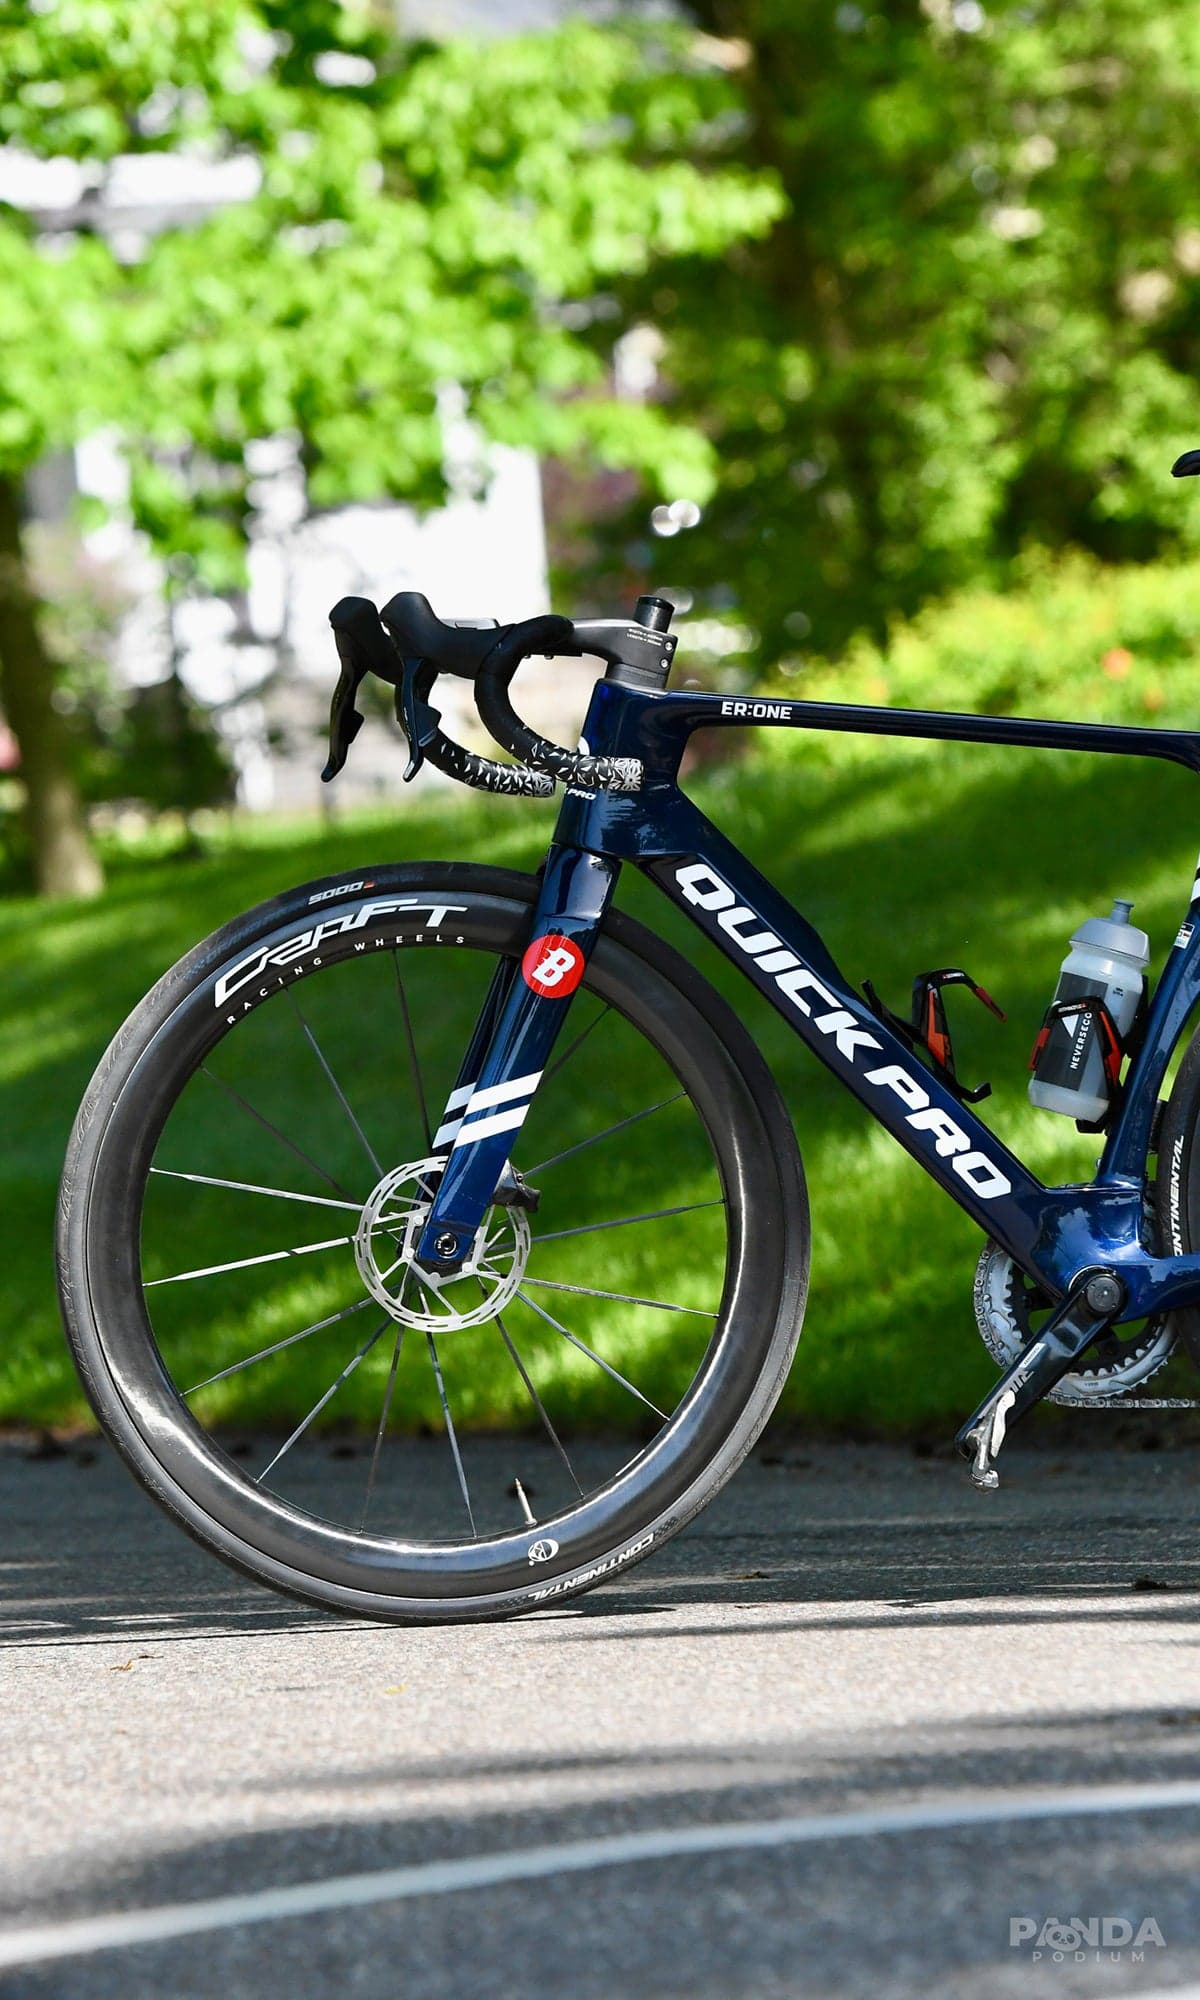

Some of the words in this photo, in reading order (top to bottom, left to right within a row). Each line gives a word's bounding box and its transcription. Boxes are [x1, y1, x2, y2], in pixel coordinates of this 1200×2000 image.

[721, 701, 793, 720] ER:ONE
[567, 788, 597, 800] PRO
[226, 957, 322, 1025] RACING
[354, 934, 465, 951] WHEELS
[531, 947, 576, 987] B
[675, 863, 884, 1064] QUICK
[863, 1065, 1012, 1199] PRO
[1070, 1011, 1092, 1070] NEVERSECO
[1170, 1135, 1184, 1257] ONTINENTAL
[528, 1532, 654, 1601] CONTINENTAL
